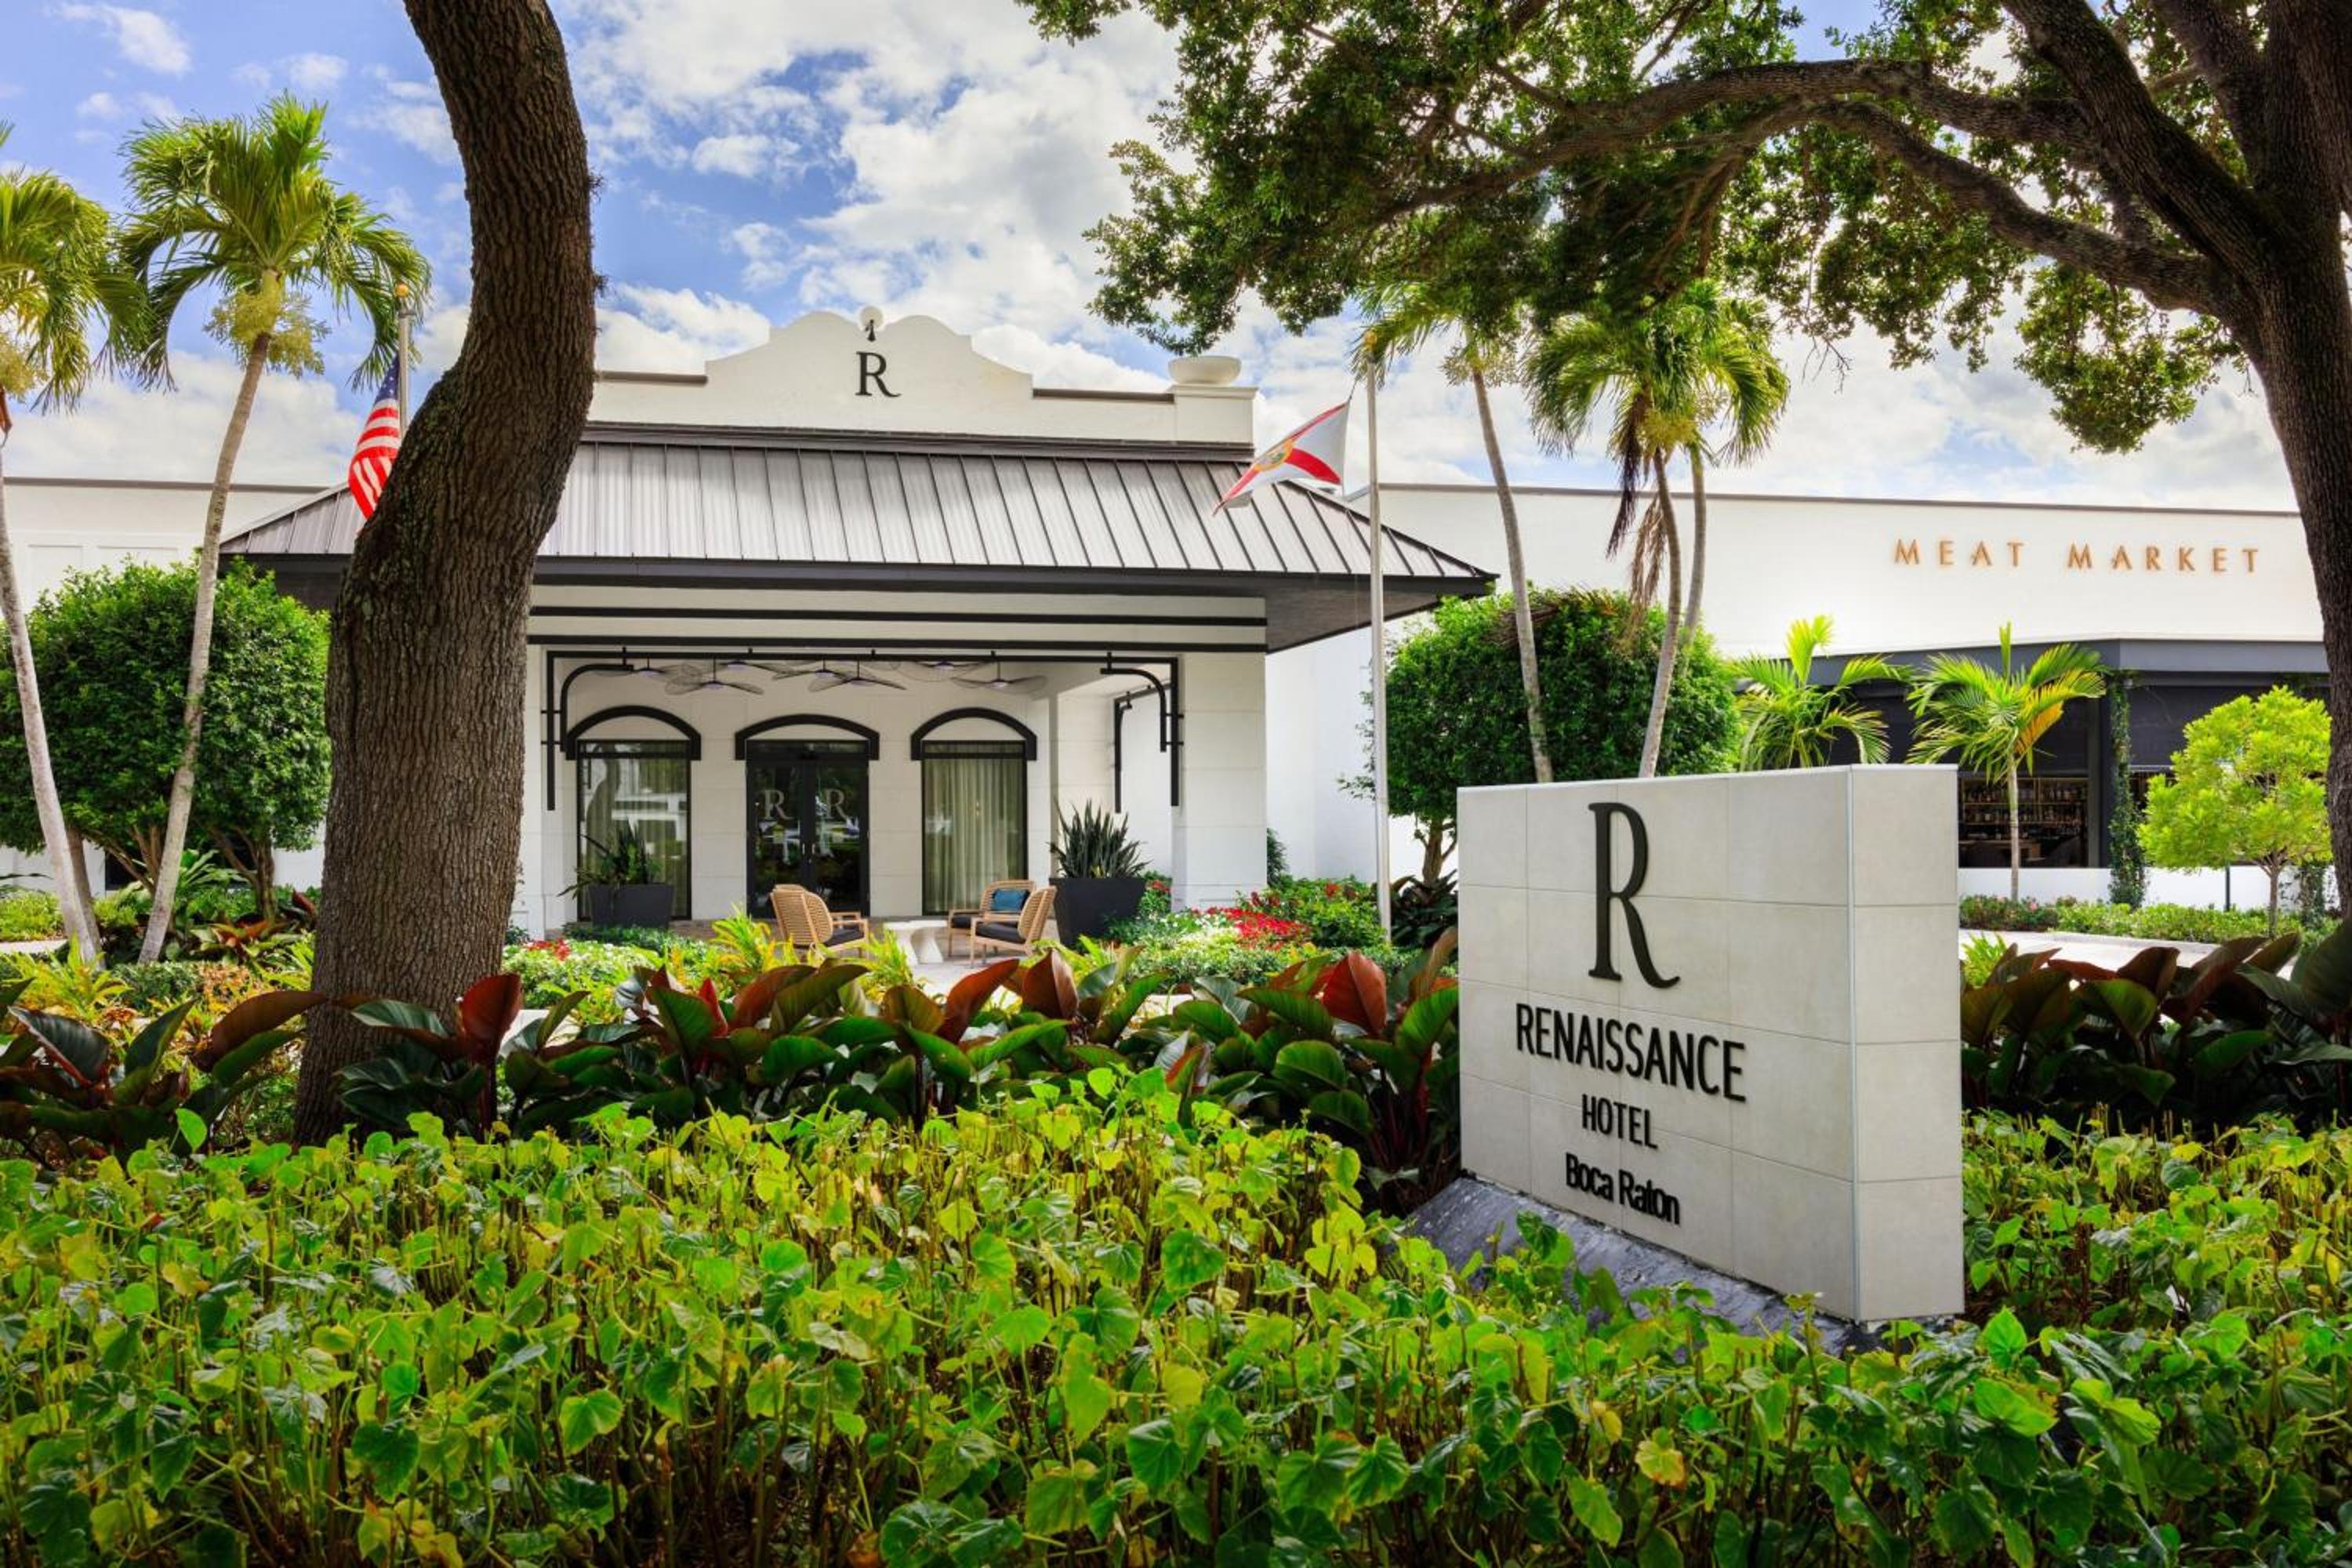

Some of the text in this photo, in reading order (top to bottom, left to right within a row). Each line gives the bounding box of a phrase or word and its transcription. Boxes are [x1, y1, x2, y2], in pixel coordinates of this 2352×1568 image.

[855, 351, 902, 397] R
[1894, 539, 2259, 573] MEAT MARKET
[763, 789, 795, 820] R
[825, 789, 855, 820] R
[1588, 801, 1681, 989] R
[1516, 1003, 1747, 1102] RENAISSANCE
[1581, 1094, 1658, 1150] HOTEL
[1565, 1152, 1680, 1225] Boca Raton
